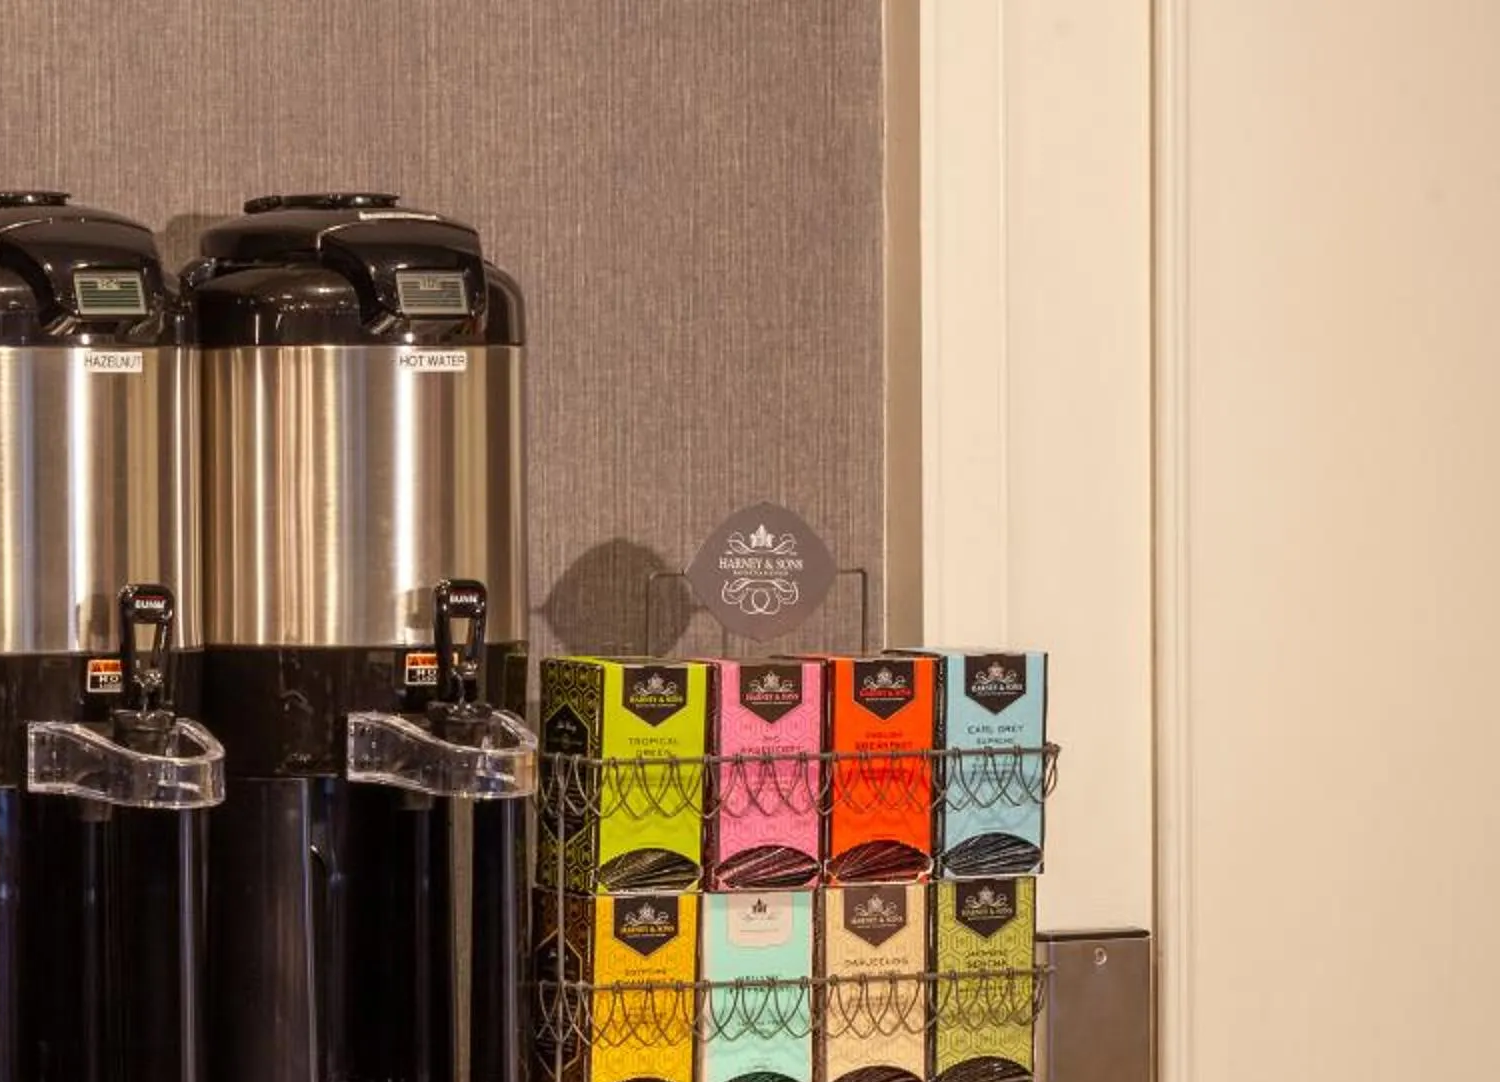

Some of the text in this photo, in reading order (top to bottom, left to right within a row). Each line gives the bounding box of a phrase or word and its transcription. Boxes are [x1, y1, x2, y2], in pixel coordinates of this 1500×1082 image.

[84, 353, 144, 368] HAZELNUT
[399, 355, 466, 367] HOT WATER
[719, 557, 762, 570] HARNEY
[776, 558, 804, 571] SONS
